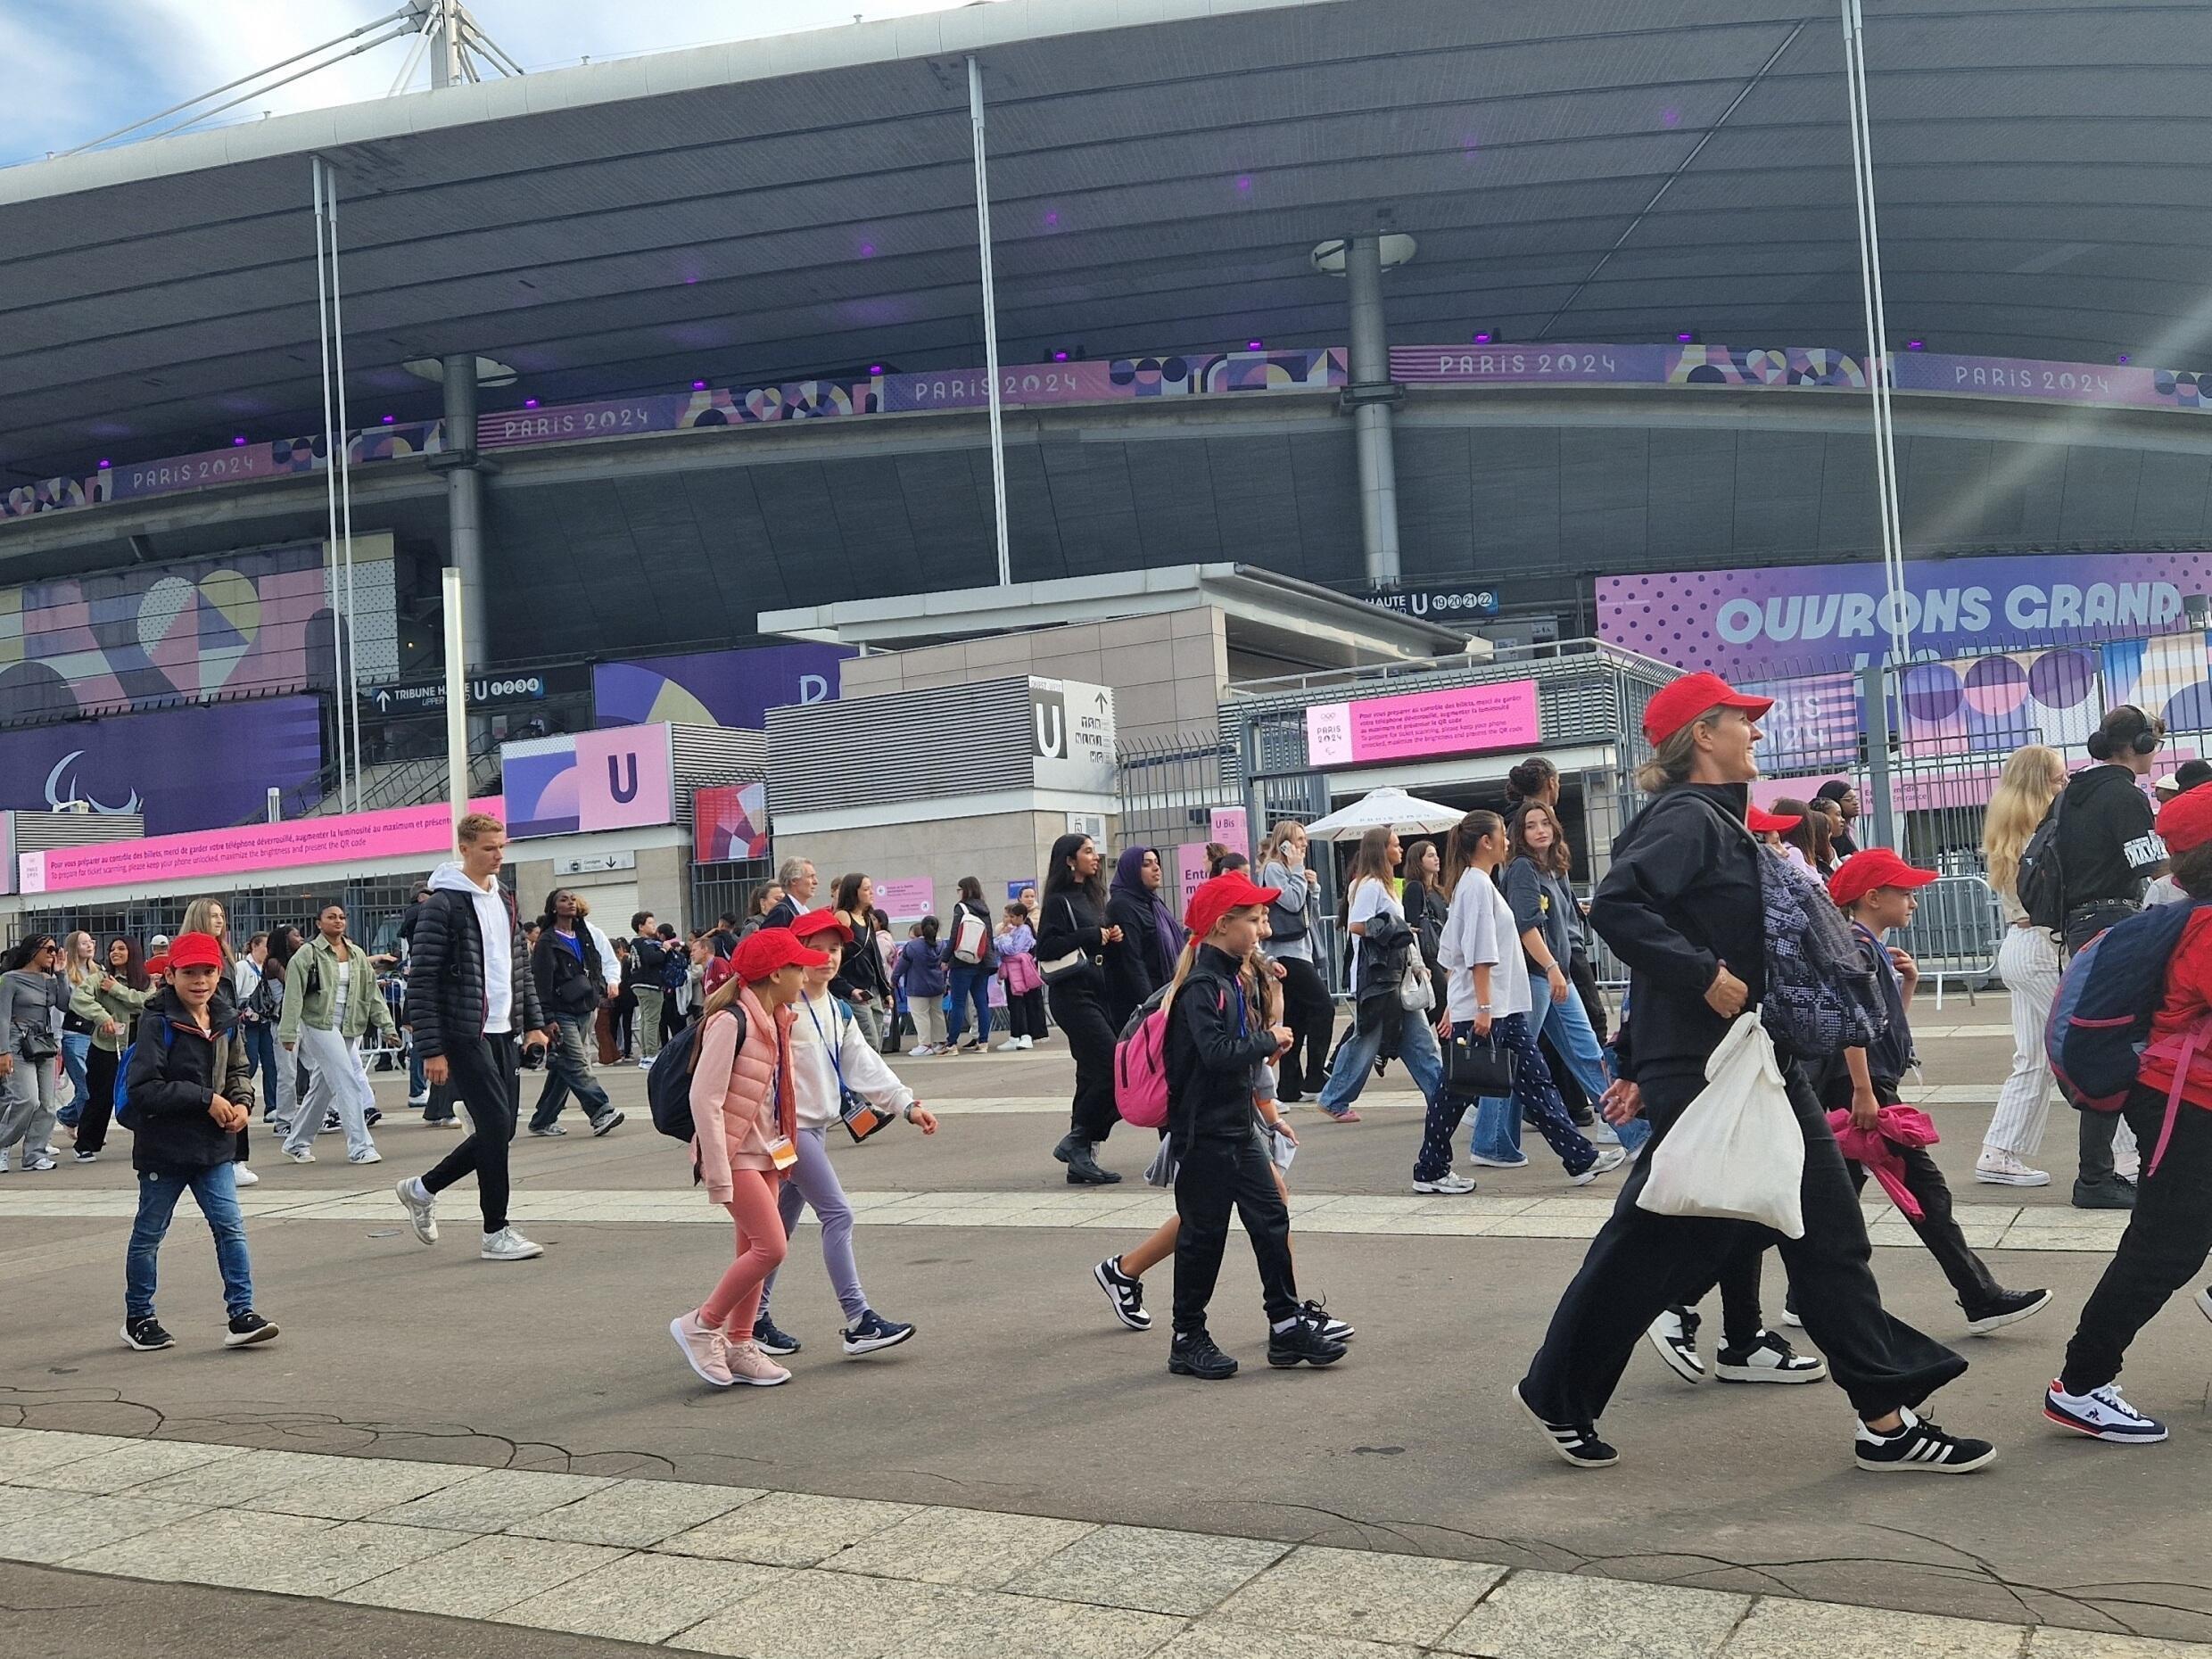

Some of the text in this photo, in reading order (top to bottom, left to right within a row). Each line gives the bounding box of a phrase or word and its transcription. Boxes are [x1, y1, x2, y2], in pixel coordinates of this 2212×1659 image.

[1539, 354, 1614, 373] 2024
[1005, 373, 1076, 394] 2024
[2043, 371, 2109, 392] 2024
[584, 409, 648, 430] 2024
[200, 456, 253, 478] 2024
[1411, 593, 1428, 615] U
[1715, 582, 2182, 644] OUVRONS GRAND
[394, 687, 435, 701] TRIBUNE
[474, 680, 488, 701] U
[422, 697, 444, 706] UPPER
[1036, 703, 1061, 757] U
[607, 753, 638, 804] U
[1216, 820, 1222, 829] U
[1223, 819, 1235, 829] Bis
